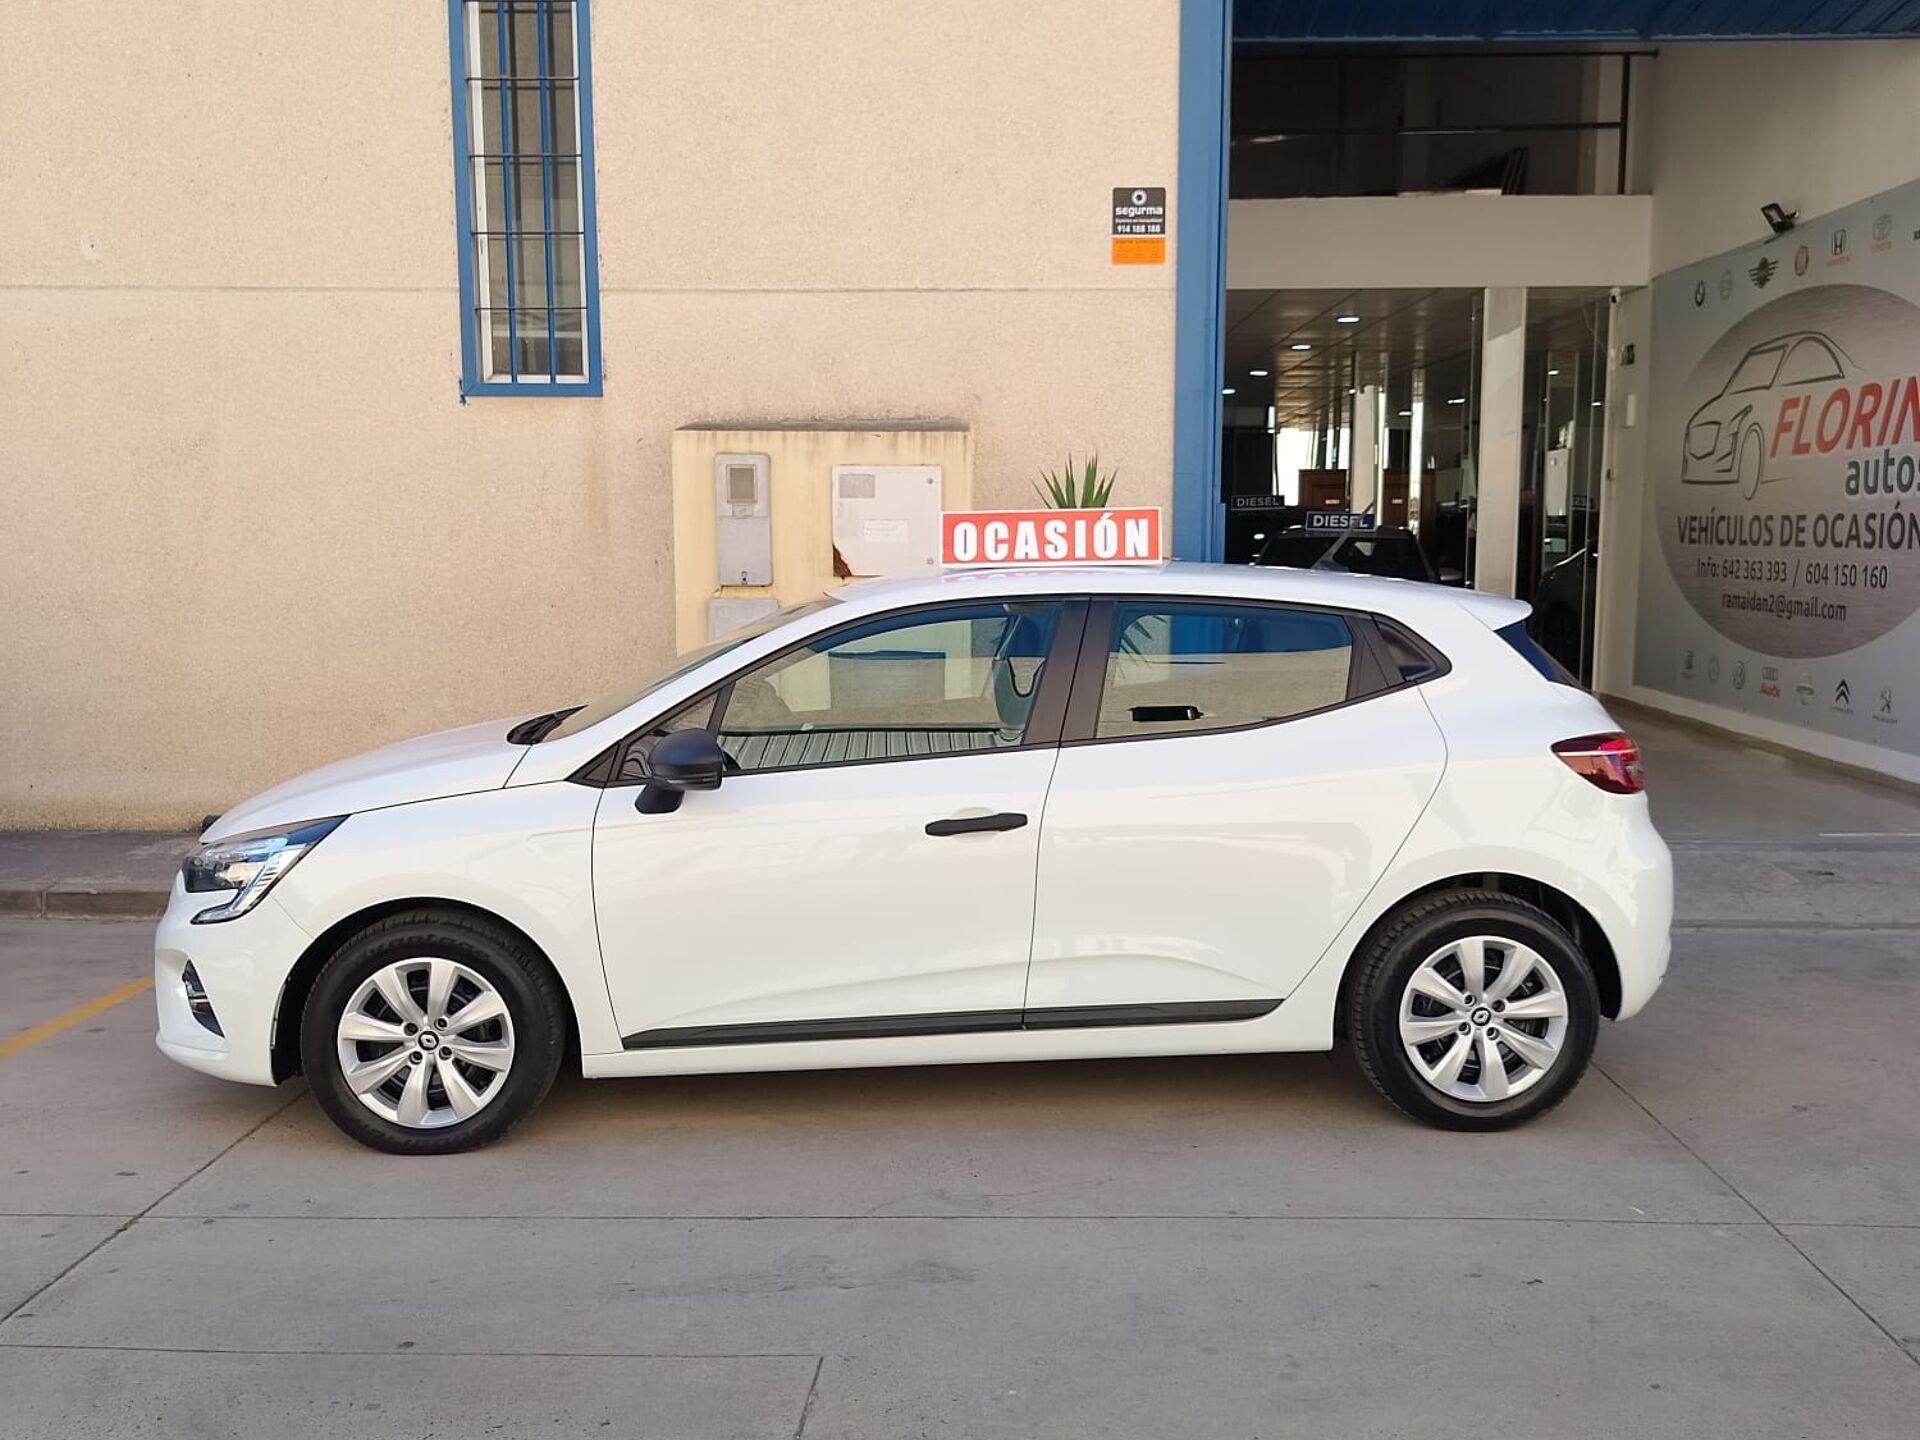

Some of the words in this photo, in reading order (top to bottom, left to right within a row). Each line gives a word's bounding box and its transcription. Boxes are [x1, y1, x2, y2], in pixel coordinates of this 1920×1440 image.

[1115, 207, 1163, 218] segurma
[1845, 448, 1920, 495] auto
[1236, 497, 1280, 507] DIESEL
[953, 512, 1149, 561] OCASIÓN
[1312, 514, 1369, 528] DIESEL
[1677, 507, 1773, 546] VEHÍCULOS
[1780, 513, 1807, 547] DE
[1813, 501, 1920, 550] OCASIÓN
[1697, 556, 1719, 578] Info:
[1722, 559, 1741, 579] 642
[1744, 560, 1763, 581] 363
[1766, 561, 1787, 582] 393
[1805, 563, 1829, 585] 604
[1834, 564, 1858, 587] 150
[1862, 564, 1888, 589] 160
[1721, 591, 1848, 621] ramaidan2@gmail.com
